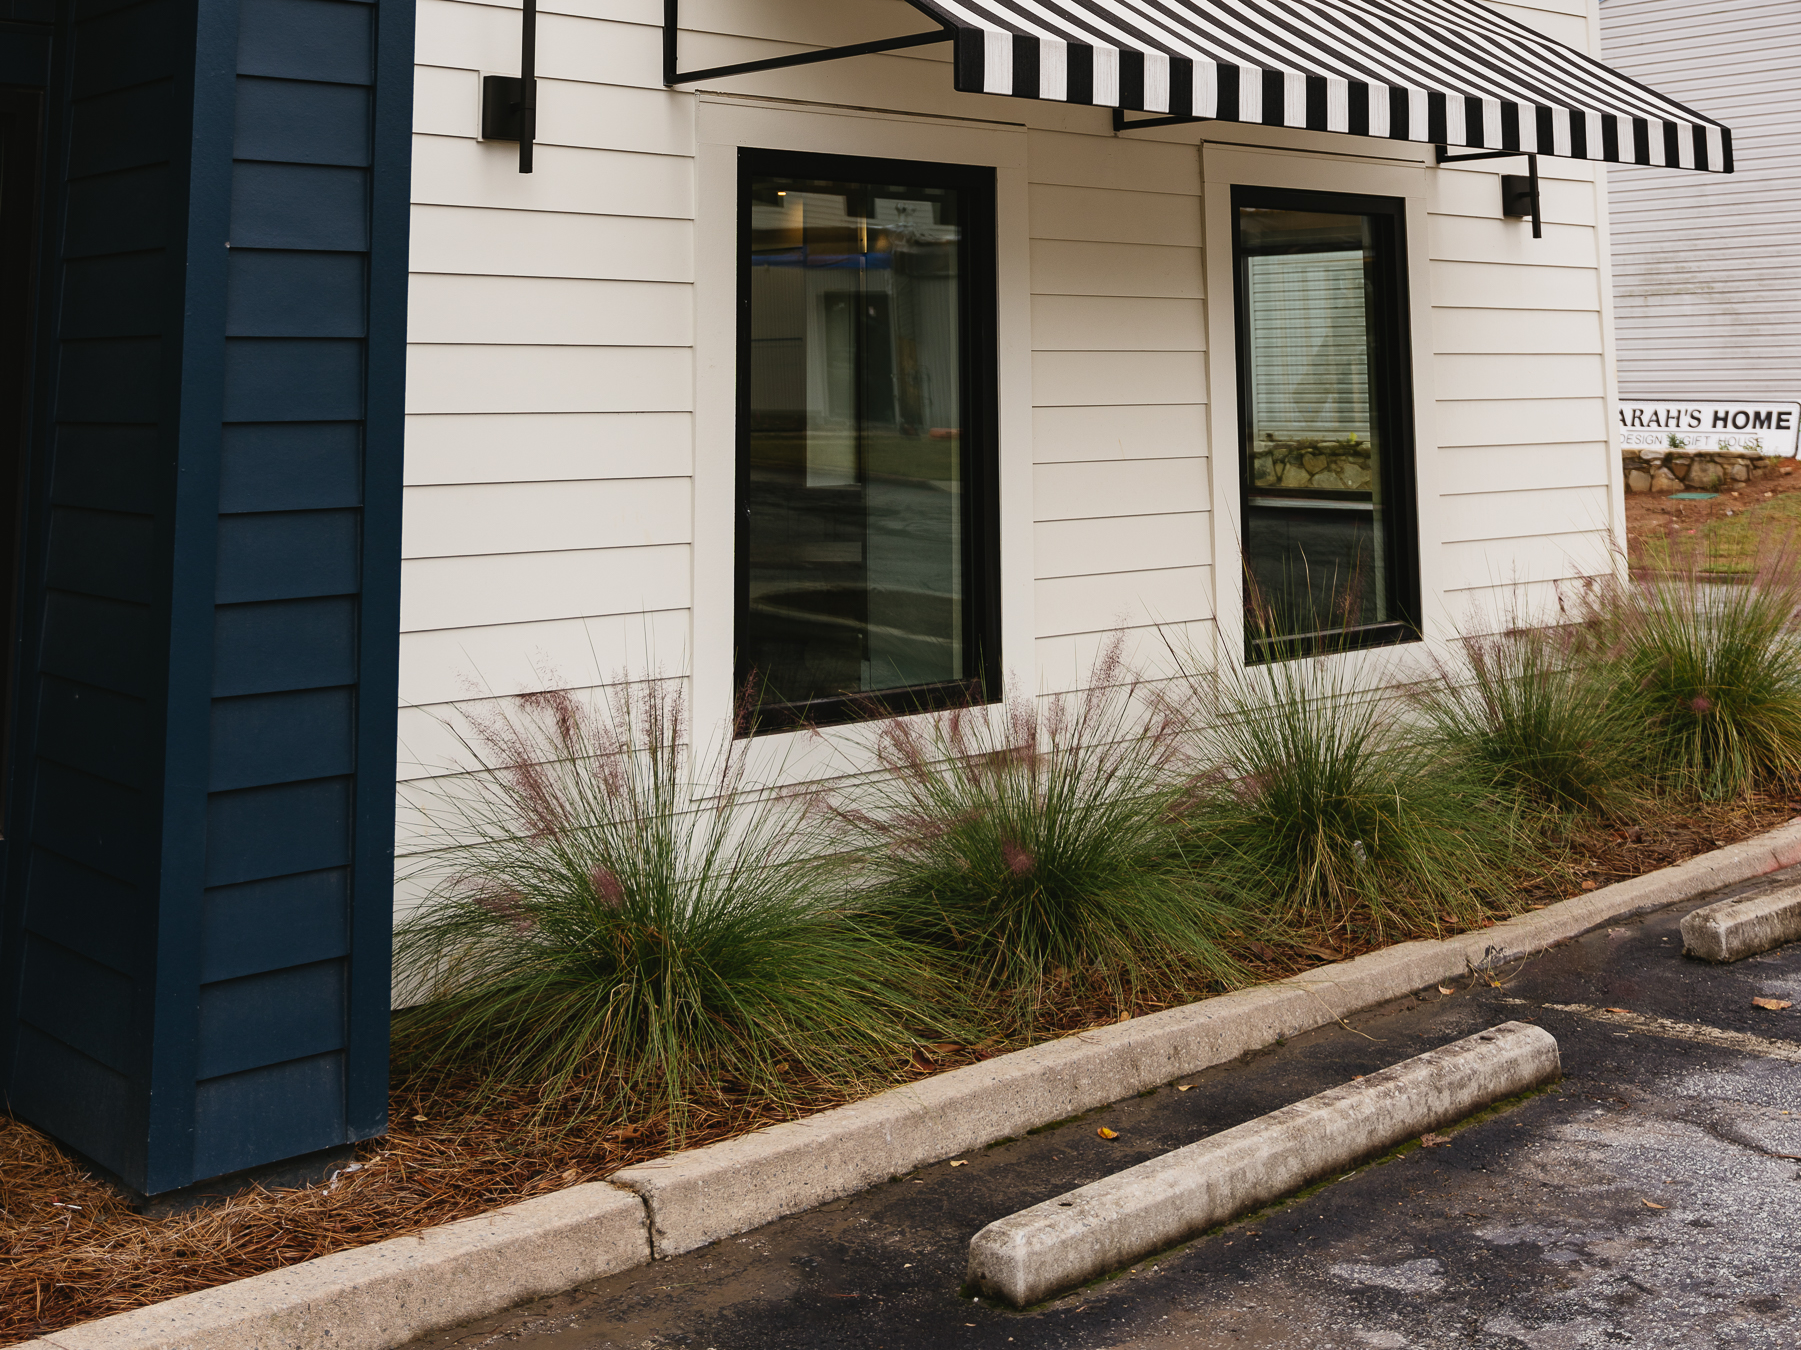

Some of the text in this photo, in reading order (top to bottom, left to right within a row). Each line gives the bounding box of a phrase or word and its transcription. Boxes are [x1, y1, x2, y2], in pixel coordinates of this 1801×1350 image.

[1711, 410, 1792, 430] HOME
[1619, 433, 1663, 445] DESIGN
[1682, 435, 1711, 446] GIFT
